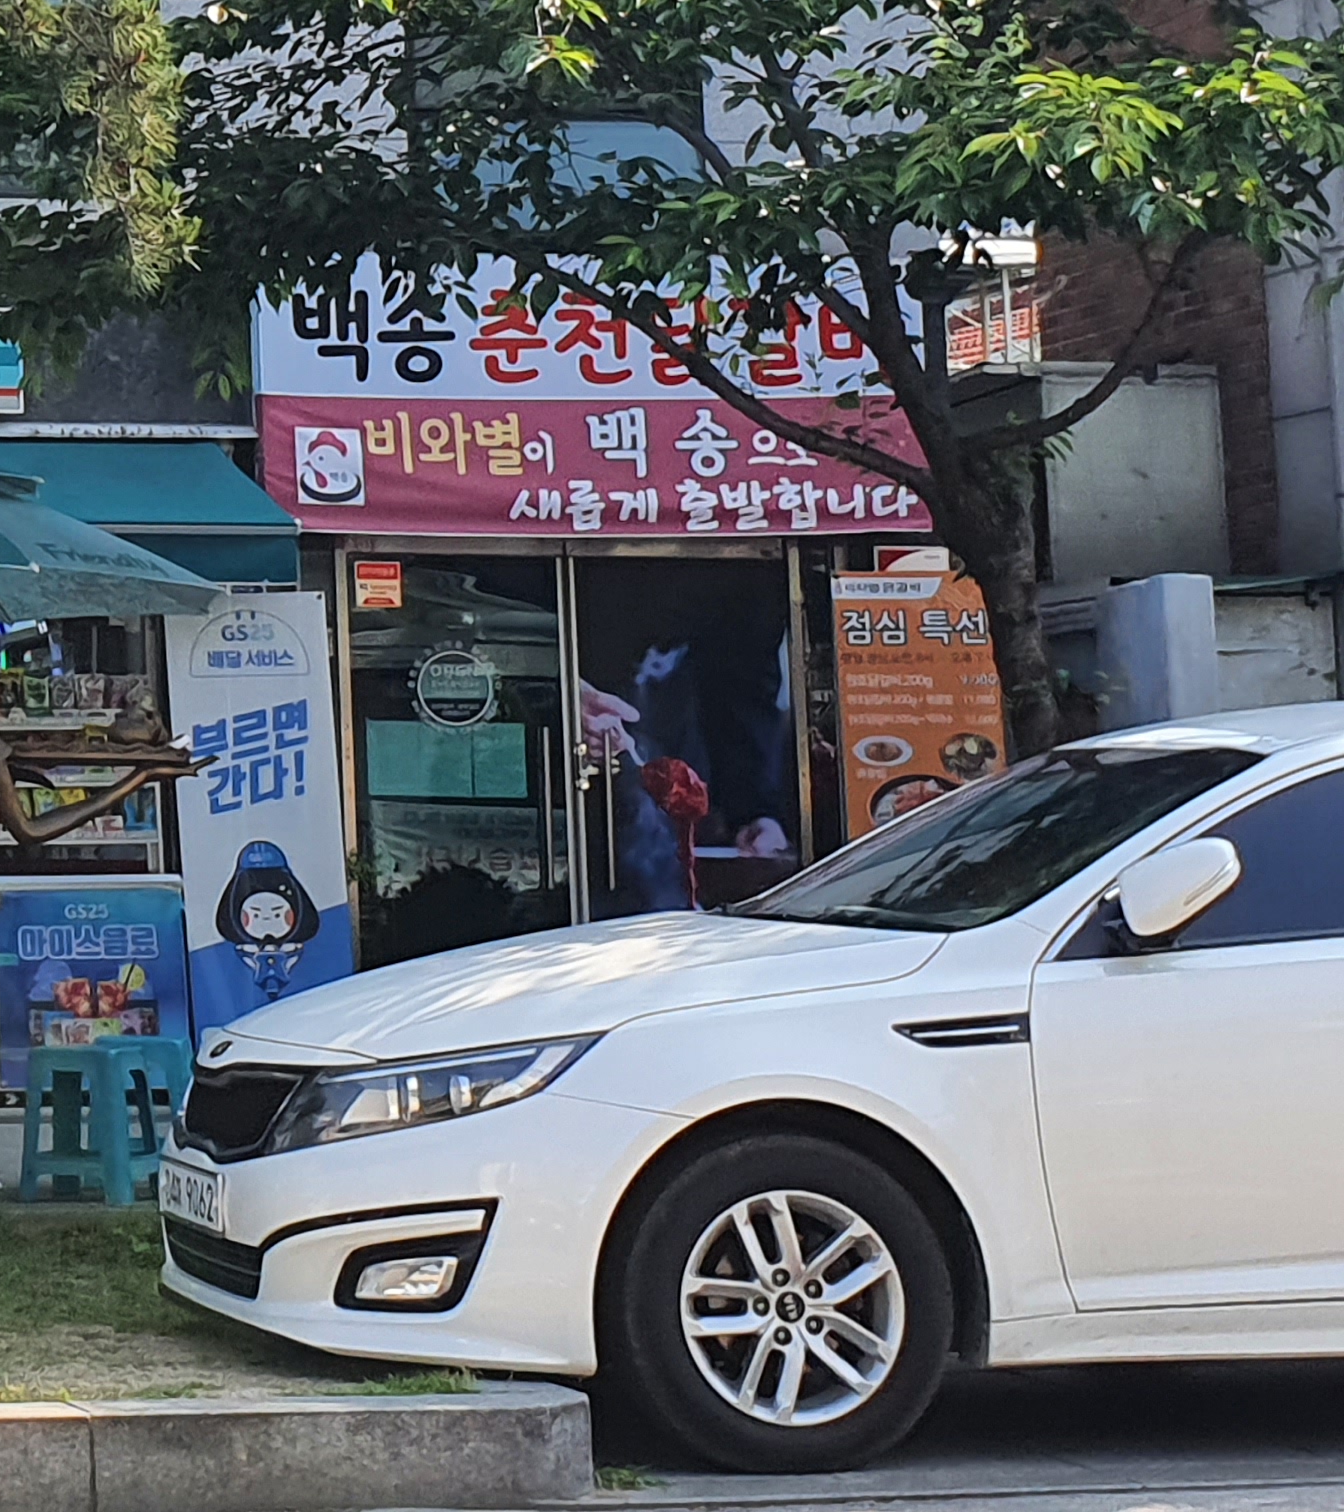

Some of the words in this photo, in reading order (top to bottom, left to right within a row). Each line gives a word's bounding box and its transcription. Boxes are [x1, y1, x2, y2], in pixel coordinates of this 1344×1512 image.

[363, 411, 555, 476] 비와별이
[509, 479, 658, 531] 새롭게
[675, 477, 918, 531] 출발합니다
[221, 624, 275, 642] GS25
[841, 608, 907, 646] 점심
[918, 608, 989, 646] 특선
[192, 699, 310, 760] 부르면
[206, 750, 306, 815] 간다!
[64, 903, 110, 920] GS25
[17, 924, 160, 961] 아이스음료
